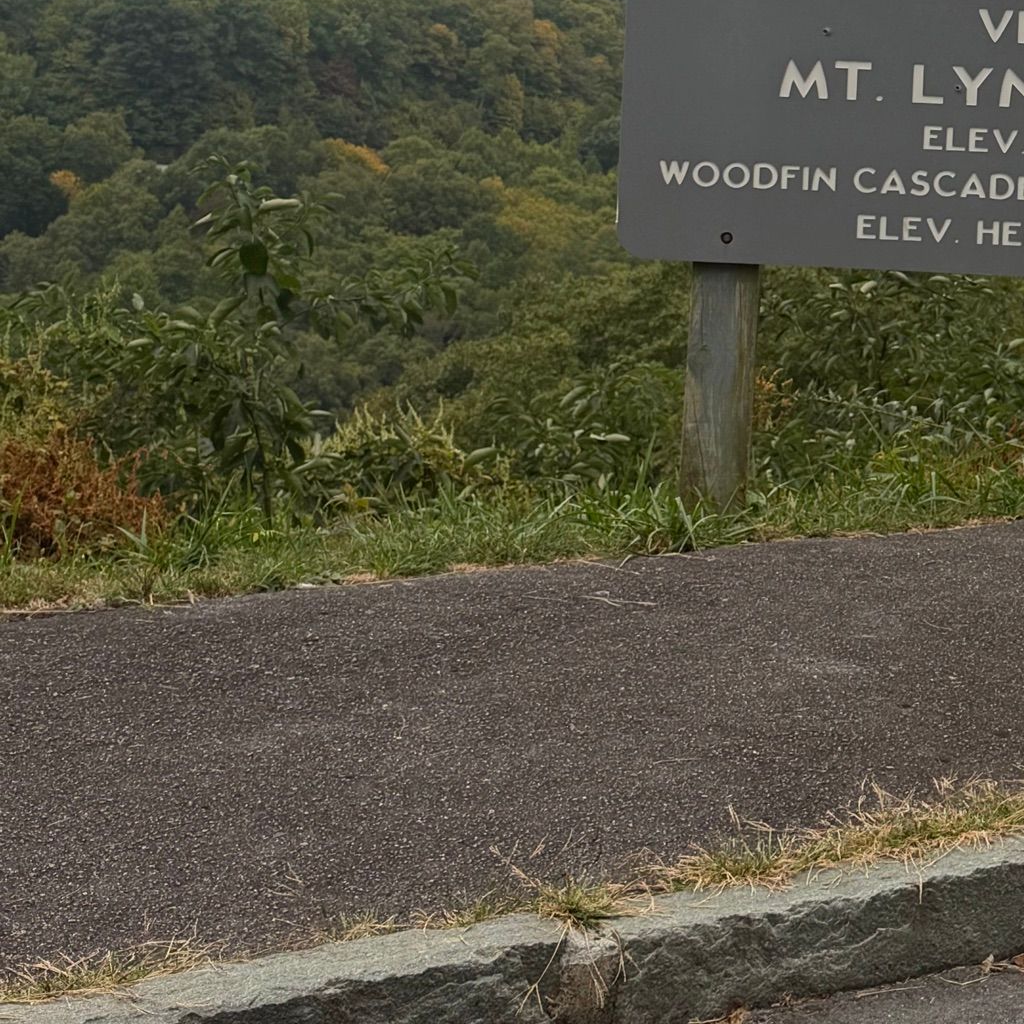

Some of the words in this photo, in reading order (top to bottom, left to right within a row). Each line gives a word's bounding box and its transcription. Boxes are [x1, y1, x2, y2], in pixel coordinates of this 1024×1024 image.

[779, 60, 883, 101] MT.
[923, 126, 1024, 154] ELEV.
[660, 161, 836, 191] WOODFIN
[857, 215, 958, 243] ELEV.
